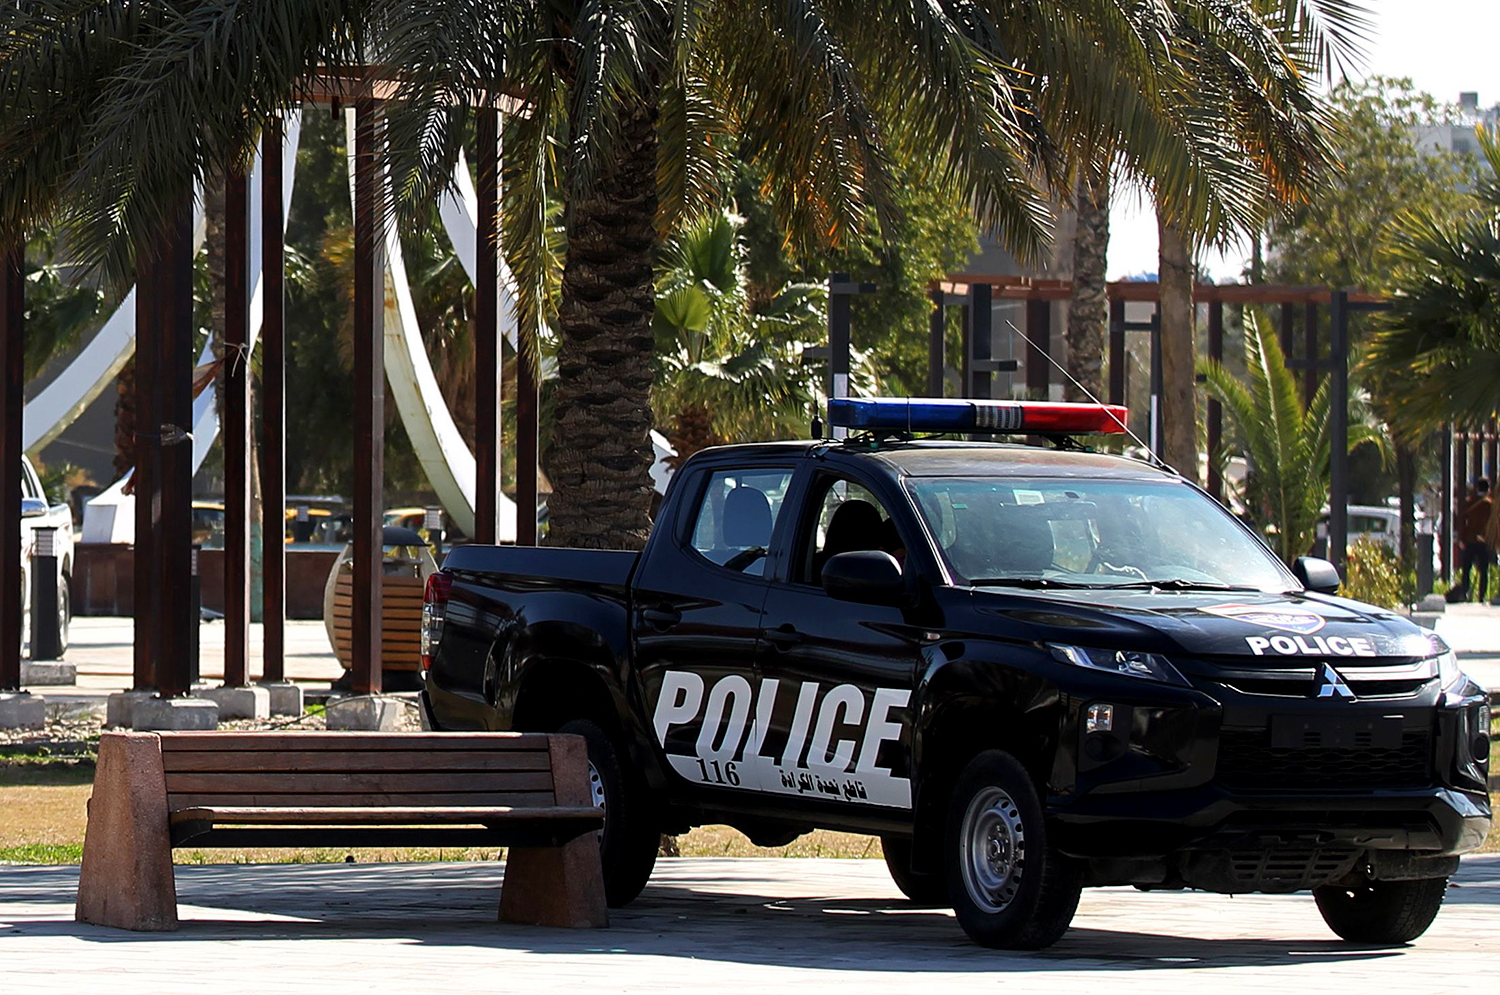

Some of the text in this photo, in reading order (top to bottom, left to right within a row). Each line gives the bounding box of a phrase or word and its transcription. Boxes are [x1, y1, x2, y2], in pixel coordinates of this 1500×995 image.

[1245, 635, 1376, 656] POLICE
[653, 670, 912, 778] POLICE
[695, 758, 740, 786] 116
